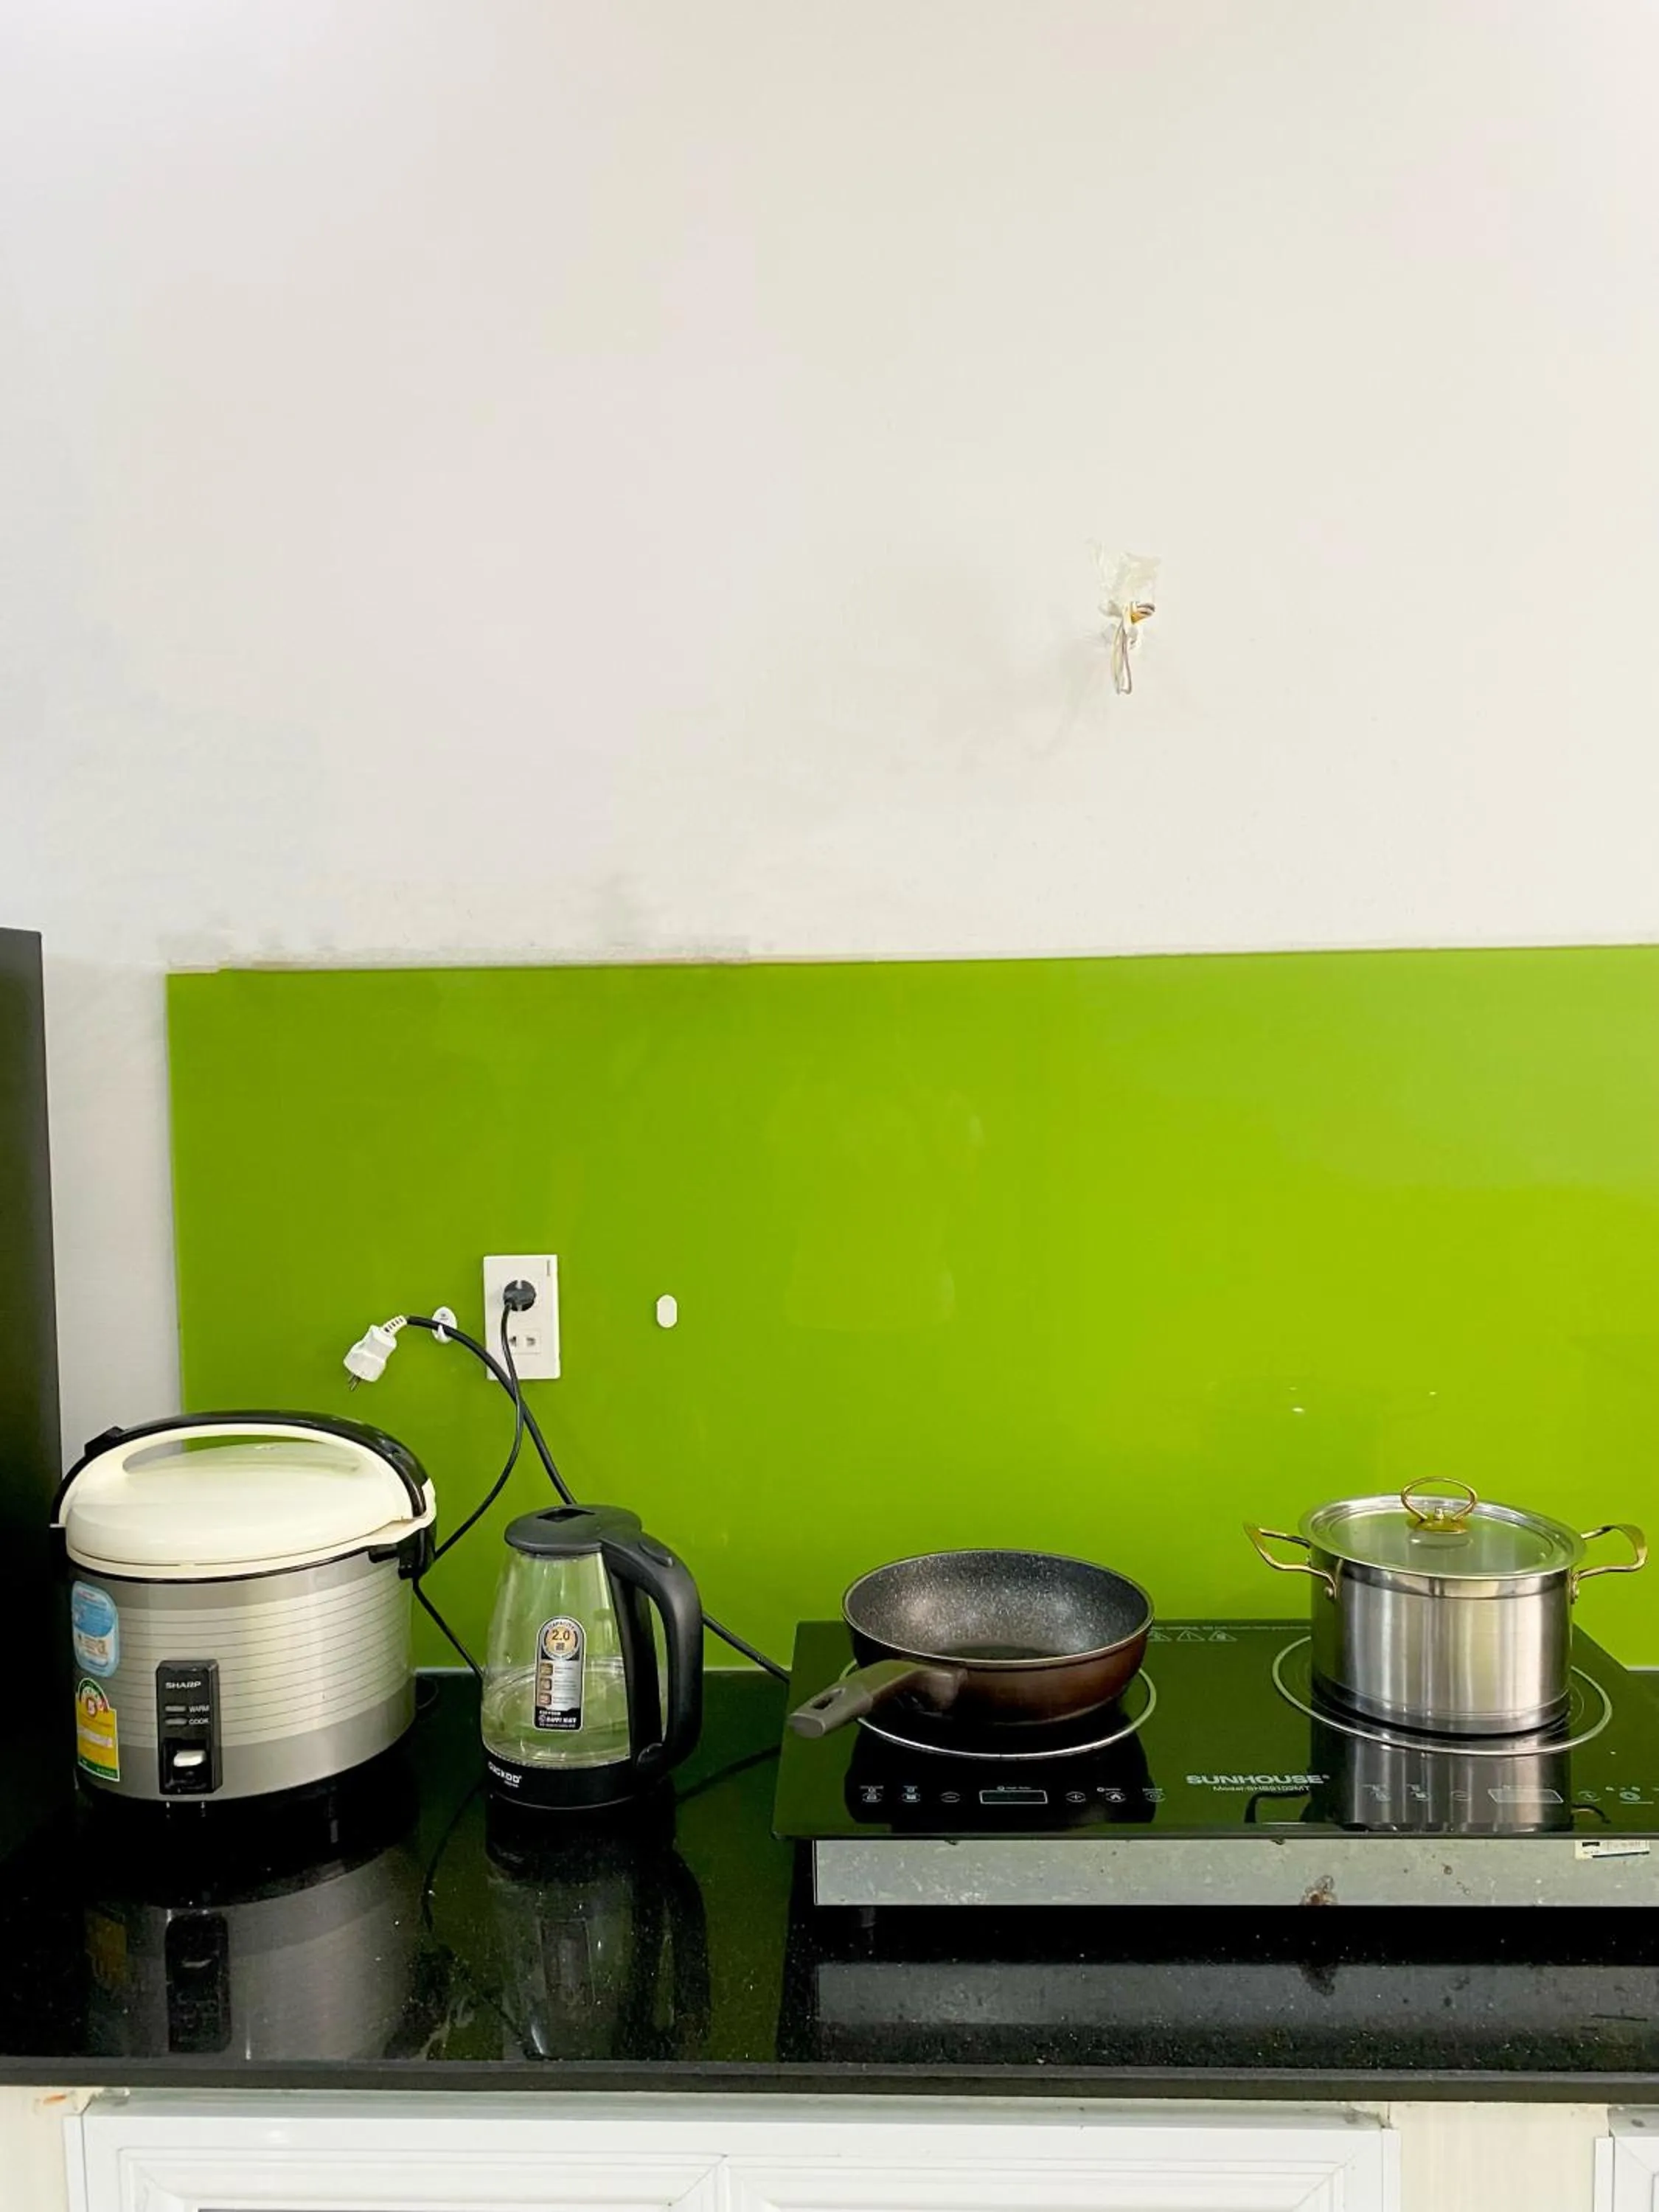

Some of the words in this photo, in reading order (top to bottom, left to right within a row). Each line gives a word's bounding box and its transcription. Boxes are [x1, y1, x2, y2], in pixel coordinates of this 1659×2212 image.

[552, 1628, 570, 1641] 2.0
[165, 1681, 201, 1689] SHARP
[189, 1705, 210, 1713] WARM
[1186, 1775, 1324, 1784] SUNHOUSE
